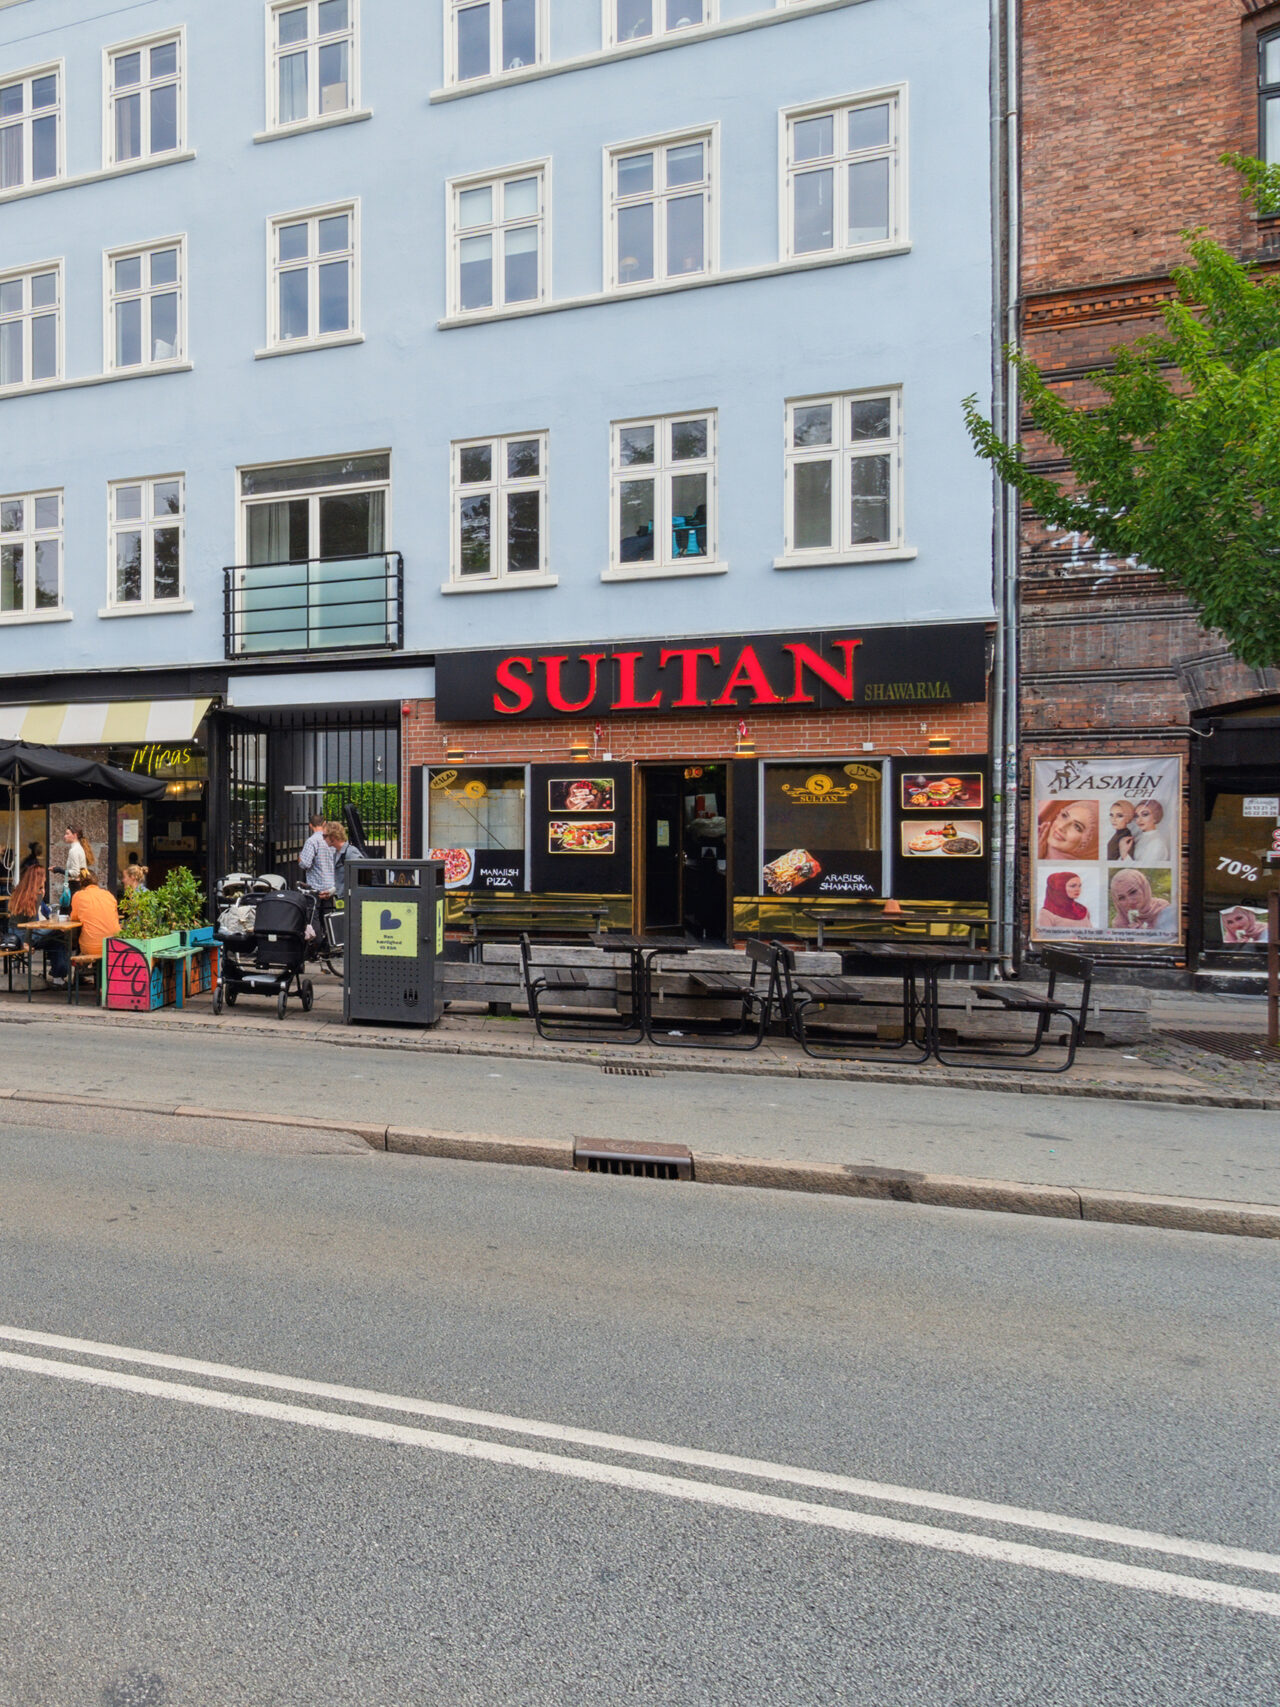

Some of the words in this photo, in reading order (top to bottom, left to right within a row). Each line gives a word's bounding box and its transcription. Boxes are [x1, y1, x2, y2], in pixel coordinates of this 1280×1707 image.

[493, 639, 864, 714] SULTAN
[865, 681, 952, 701] SHAWARMA
[432, 770, 456, 787] HALAL
[814, 780, 824, 790] S
[1124, 789, 1155, 798] CPH
[1216, 856, 1258, 882] 70%
[486, 877, 513, 887] PIZZA
[824, 874, 865, 882] ARABISK
[819, 882, 874, 891] SHAWARMA
